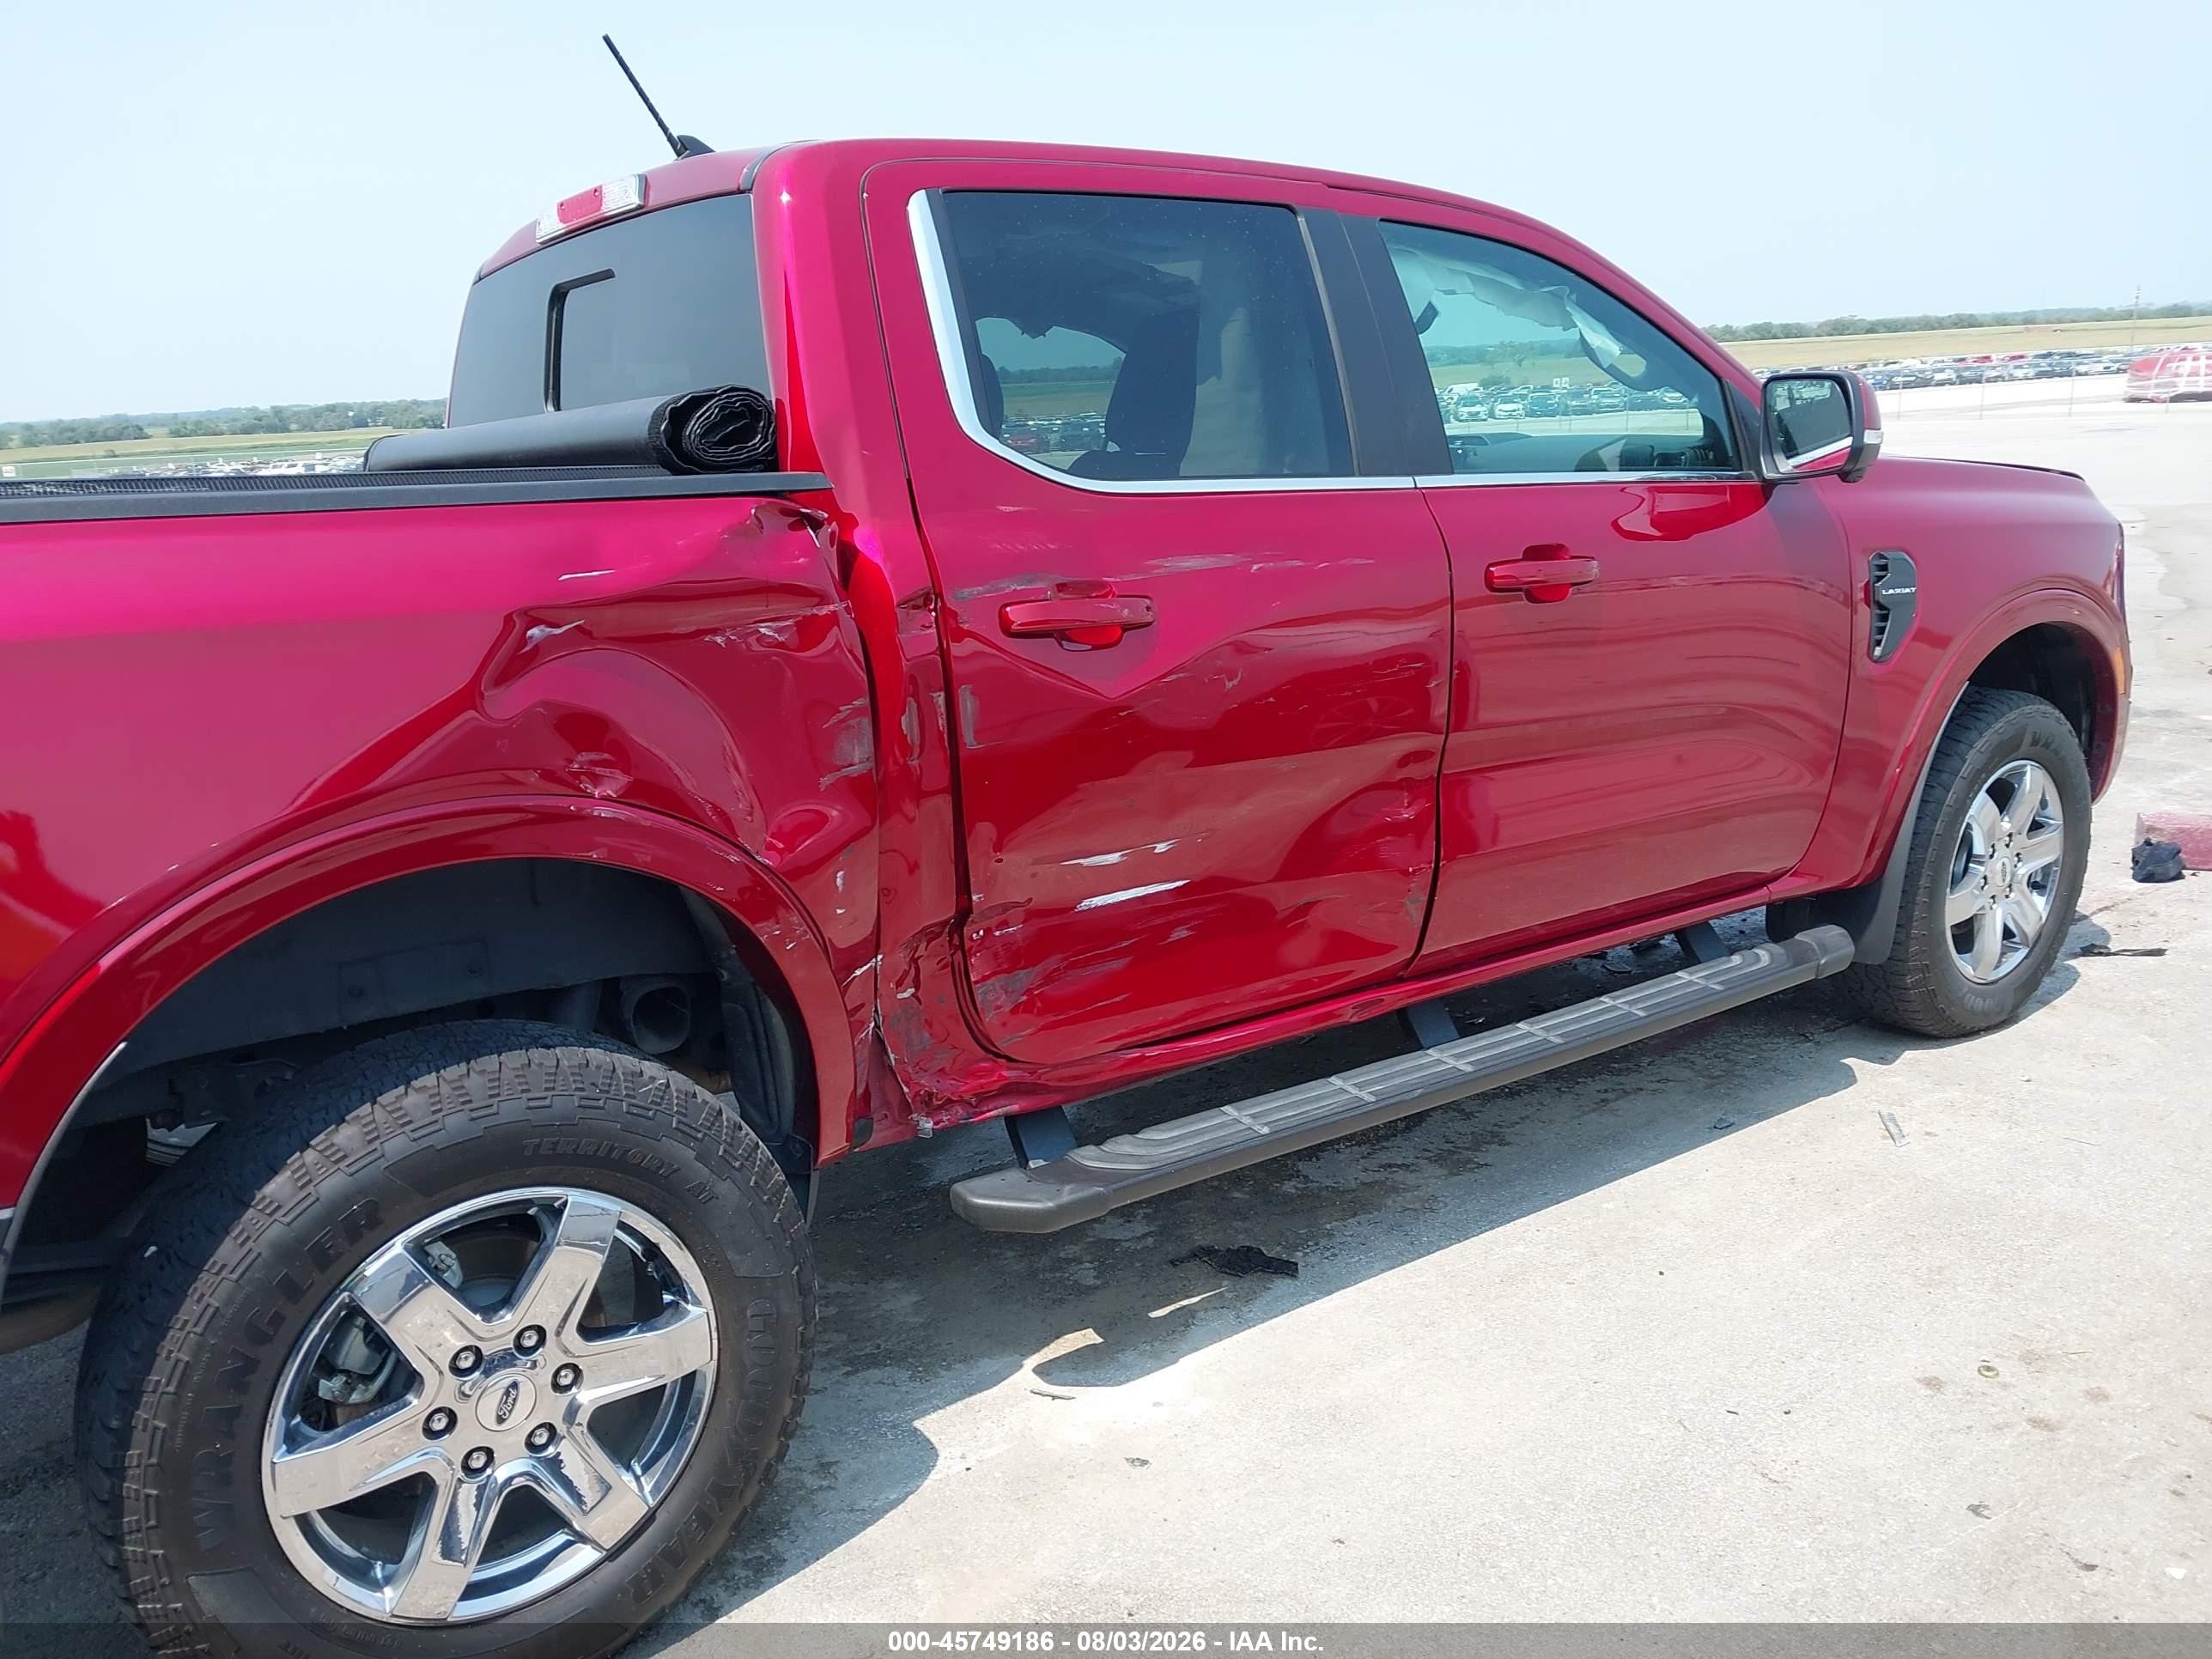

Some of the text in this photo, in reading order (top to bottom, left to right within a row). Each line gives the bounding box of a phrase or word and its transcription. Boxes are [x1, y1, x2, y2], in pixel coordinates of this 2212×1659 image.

[522, 1137, 681, 1179] TERRITORY
[191, 1197, 386, 1552] WRANGLER
[497, 1388, 518, 1419] Ford
